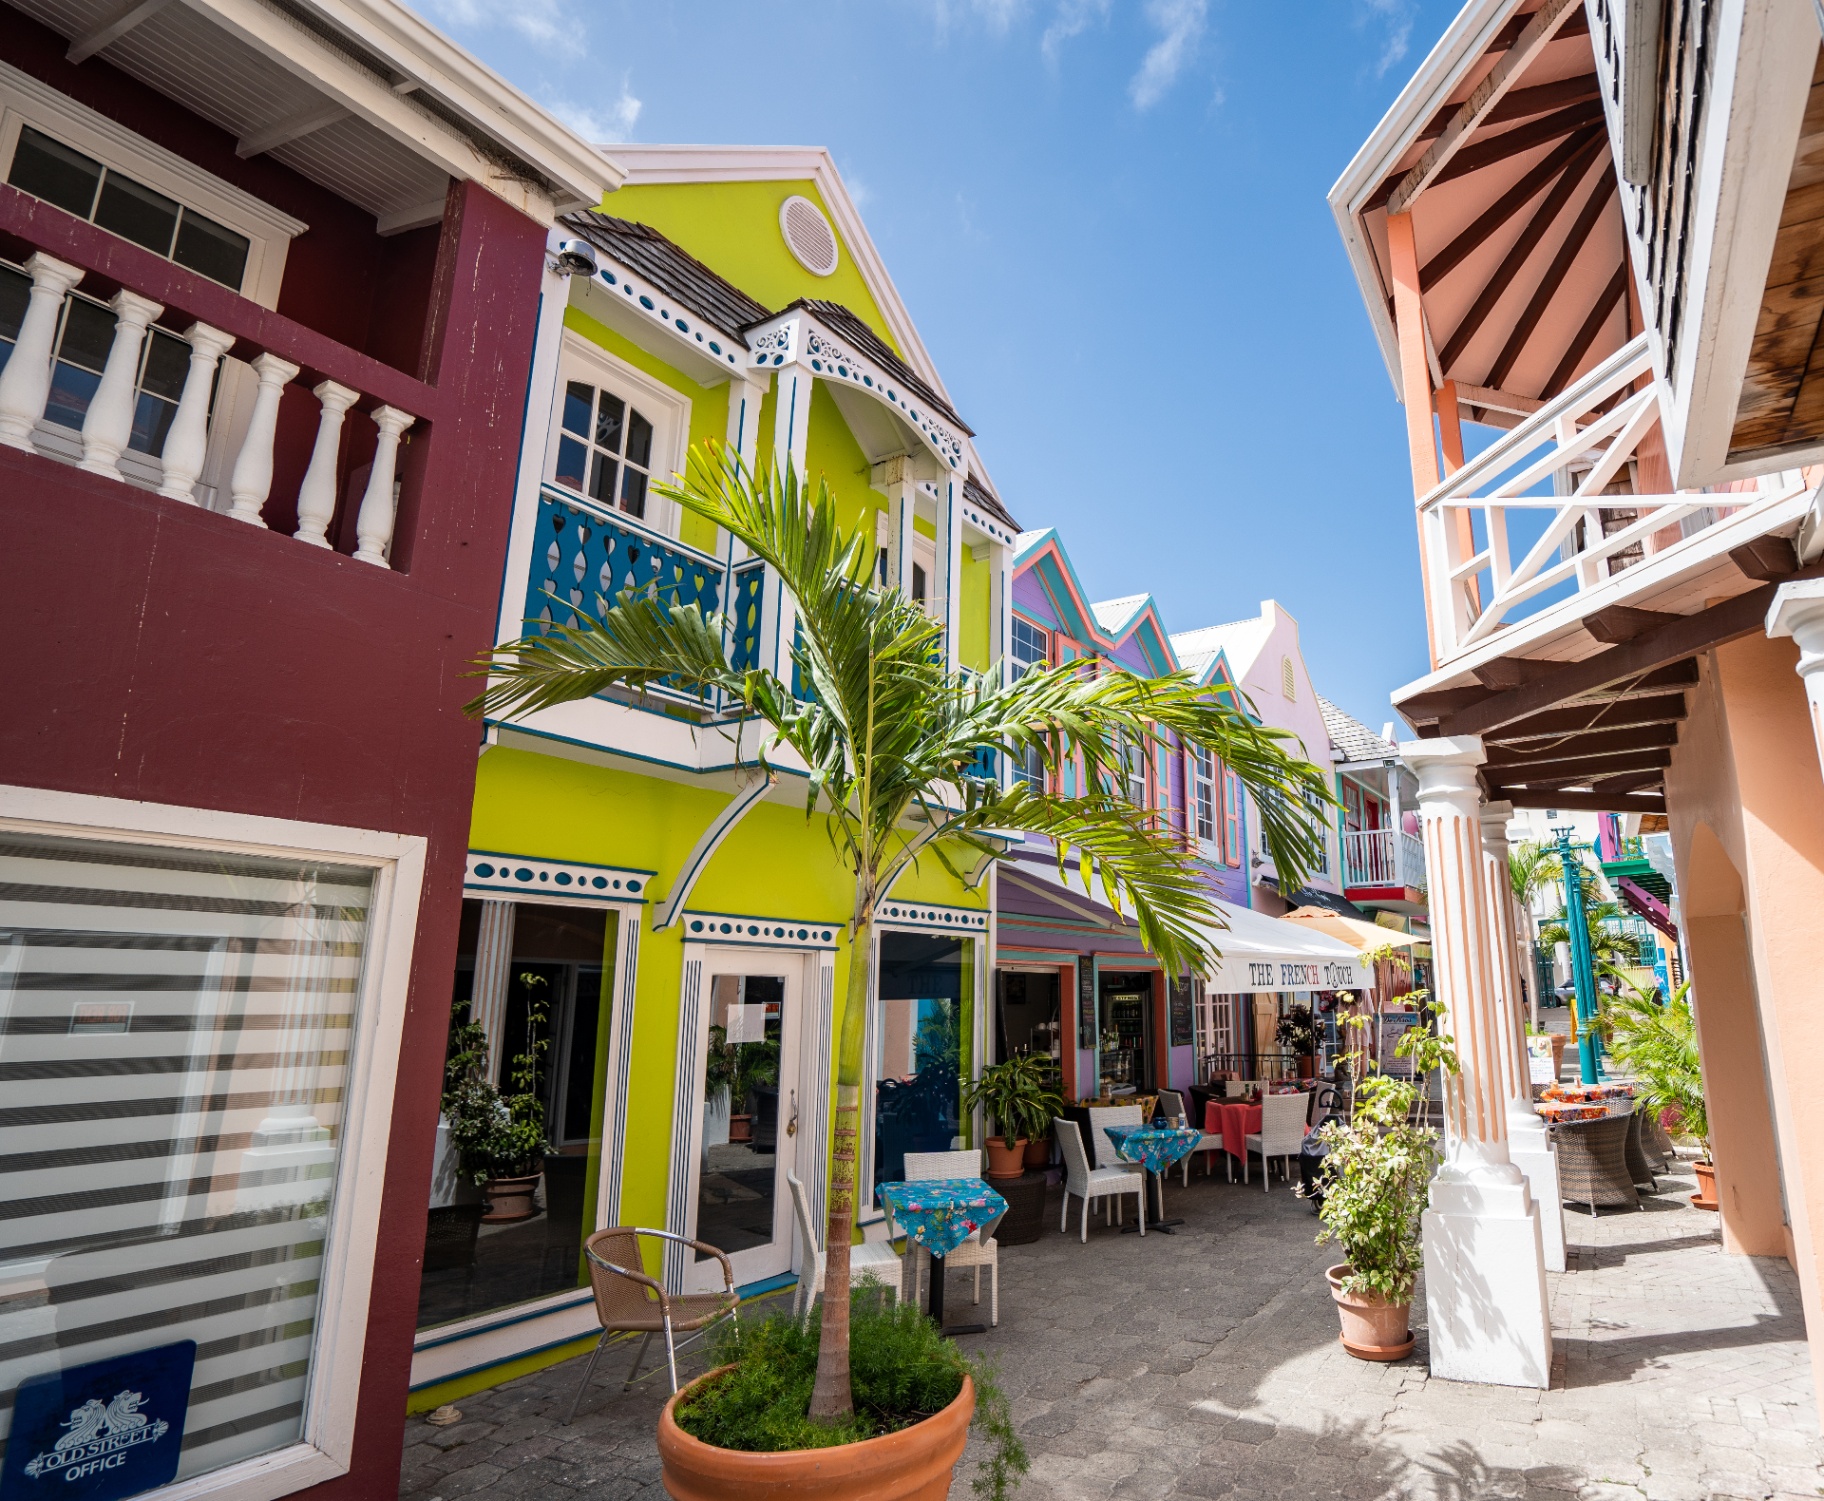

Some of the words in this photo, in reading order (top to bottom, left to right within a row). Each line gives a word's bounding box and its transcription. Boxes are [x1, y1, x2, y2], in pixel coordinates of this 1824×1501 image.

[1249, 963, 1274, 986] THE
[1280, 963, 1320, 986] FRENCH
[1324, 961, 1353, 988] TOUCH
[46, 1447, 86, 1469] OLD
[87, 1427, 152, 1457] STREET
[65, 1451, 127, 1481] OFFICE
